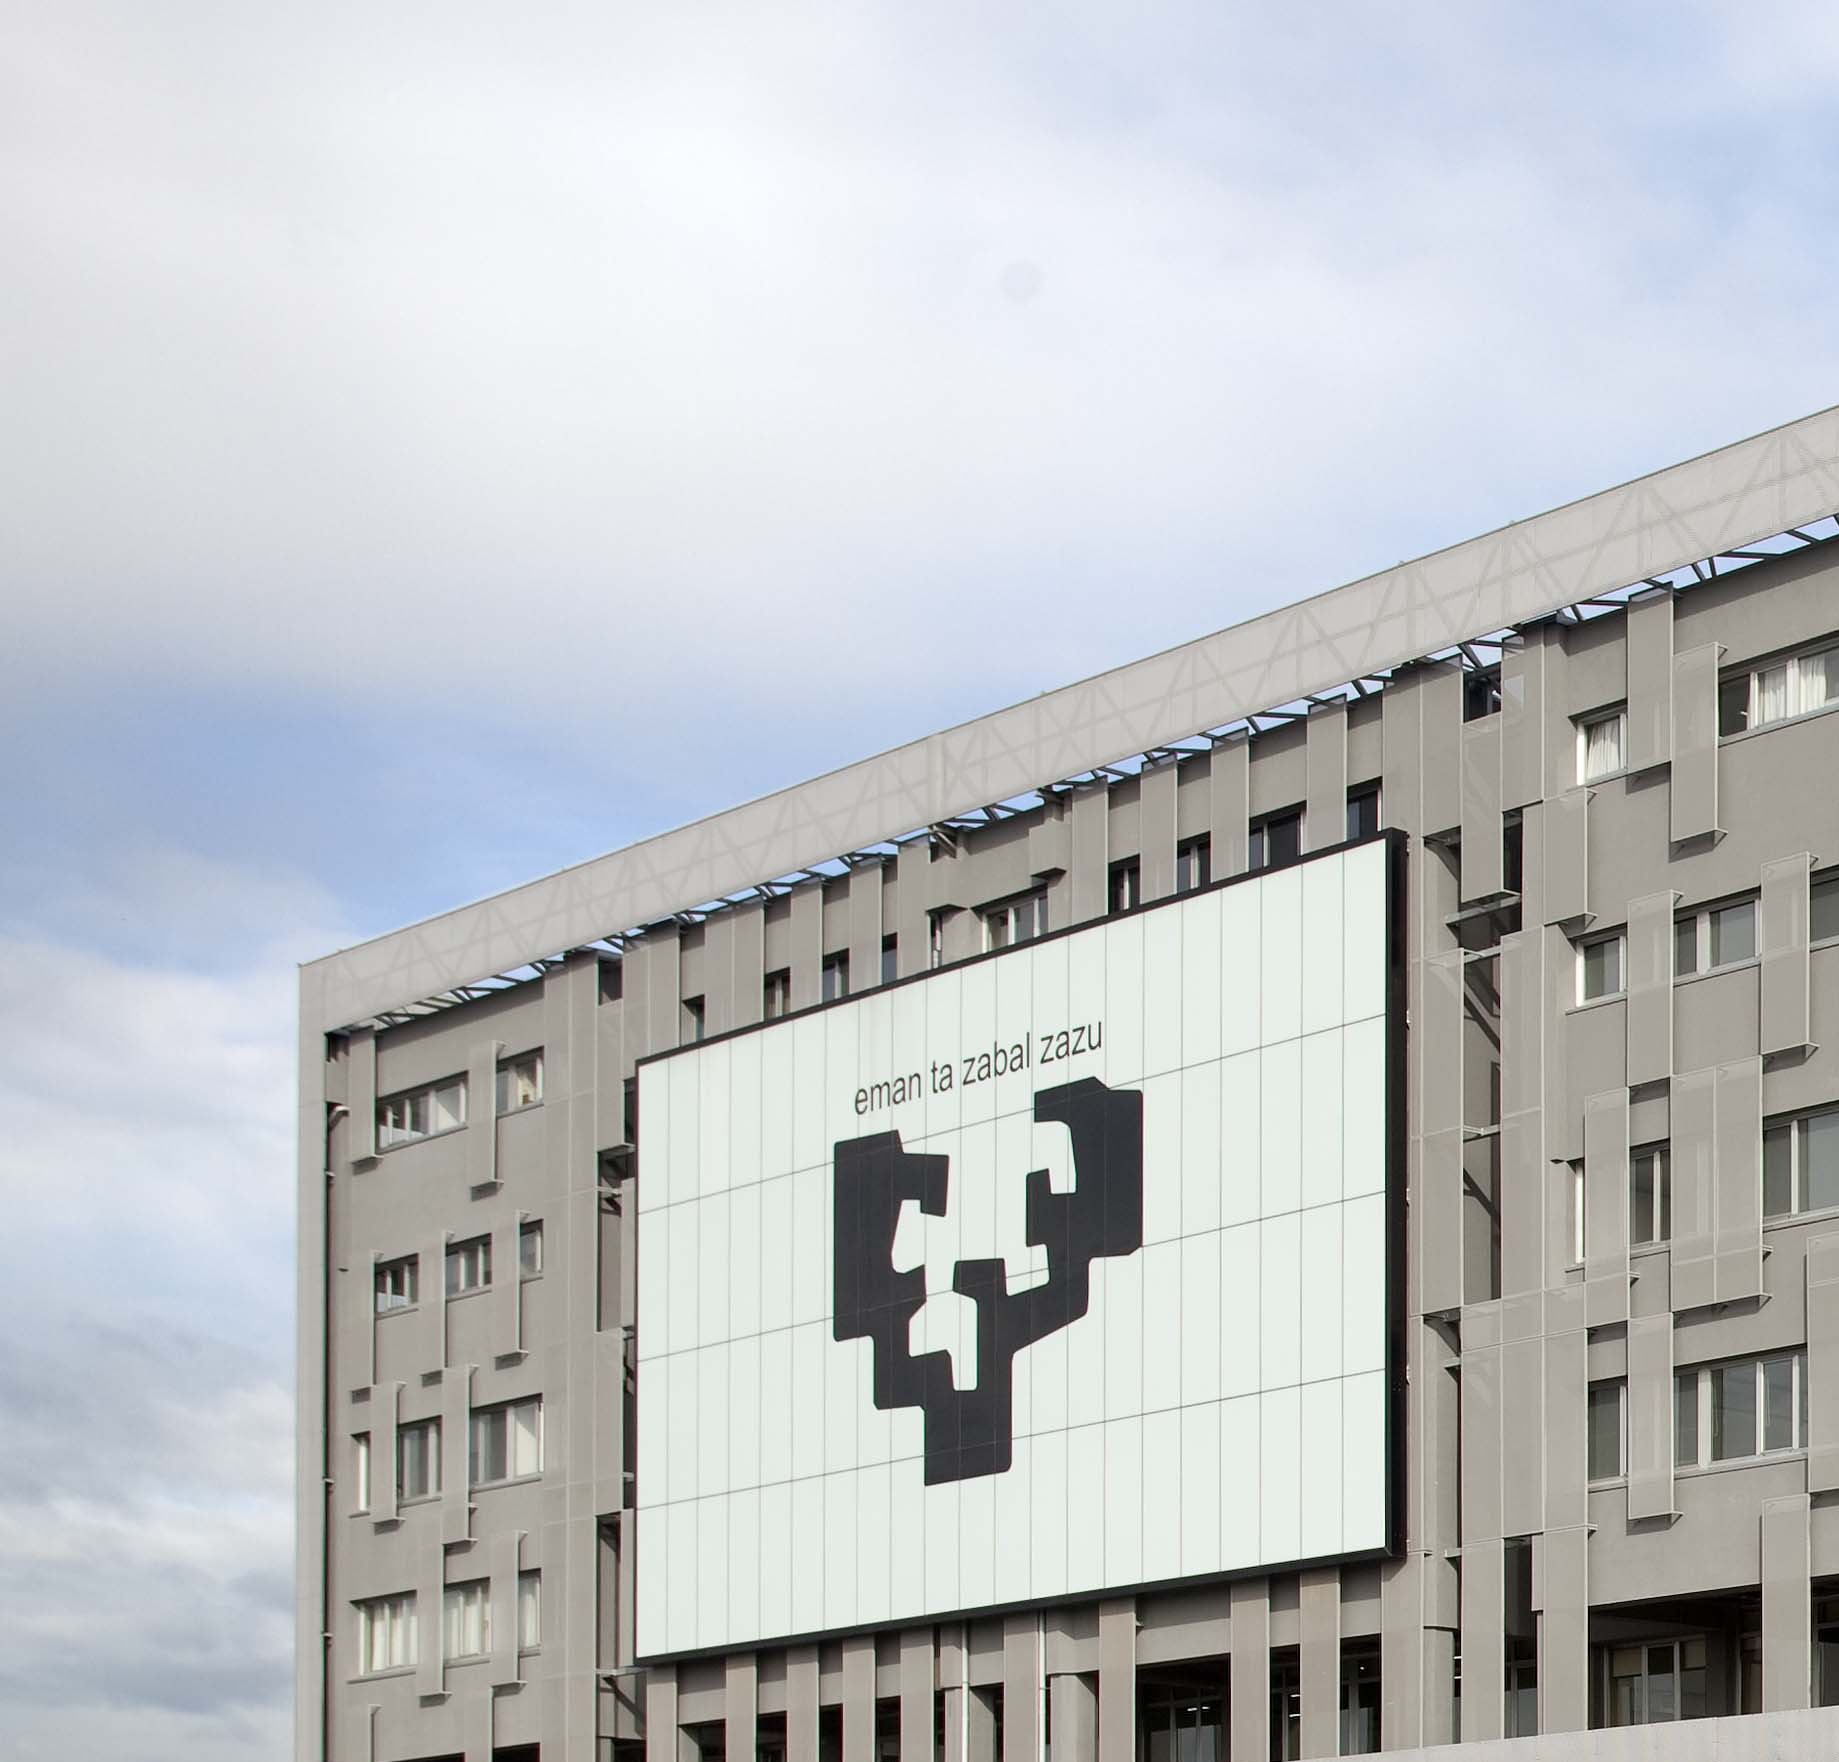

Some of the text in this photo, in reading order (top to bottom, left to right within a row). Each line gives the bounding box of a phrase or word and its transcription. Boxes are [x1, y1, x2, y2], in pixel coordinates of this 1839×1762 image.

[854, 1021, 1102, 1115] eman ta zabal zazu
